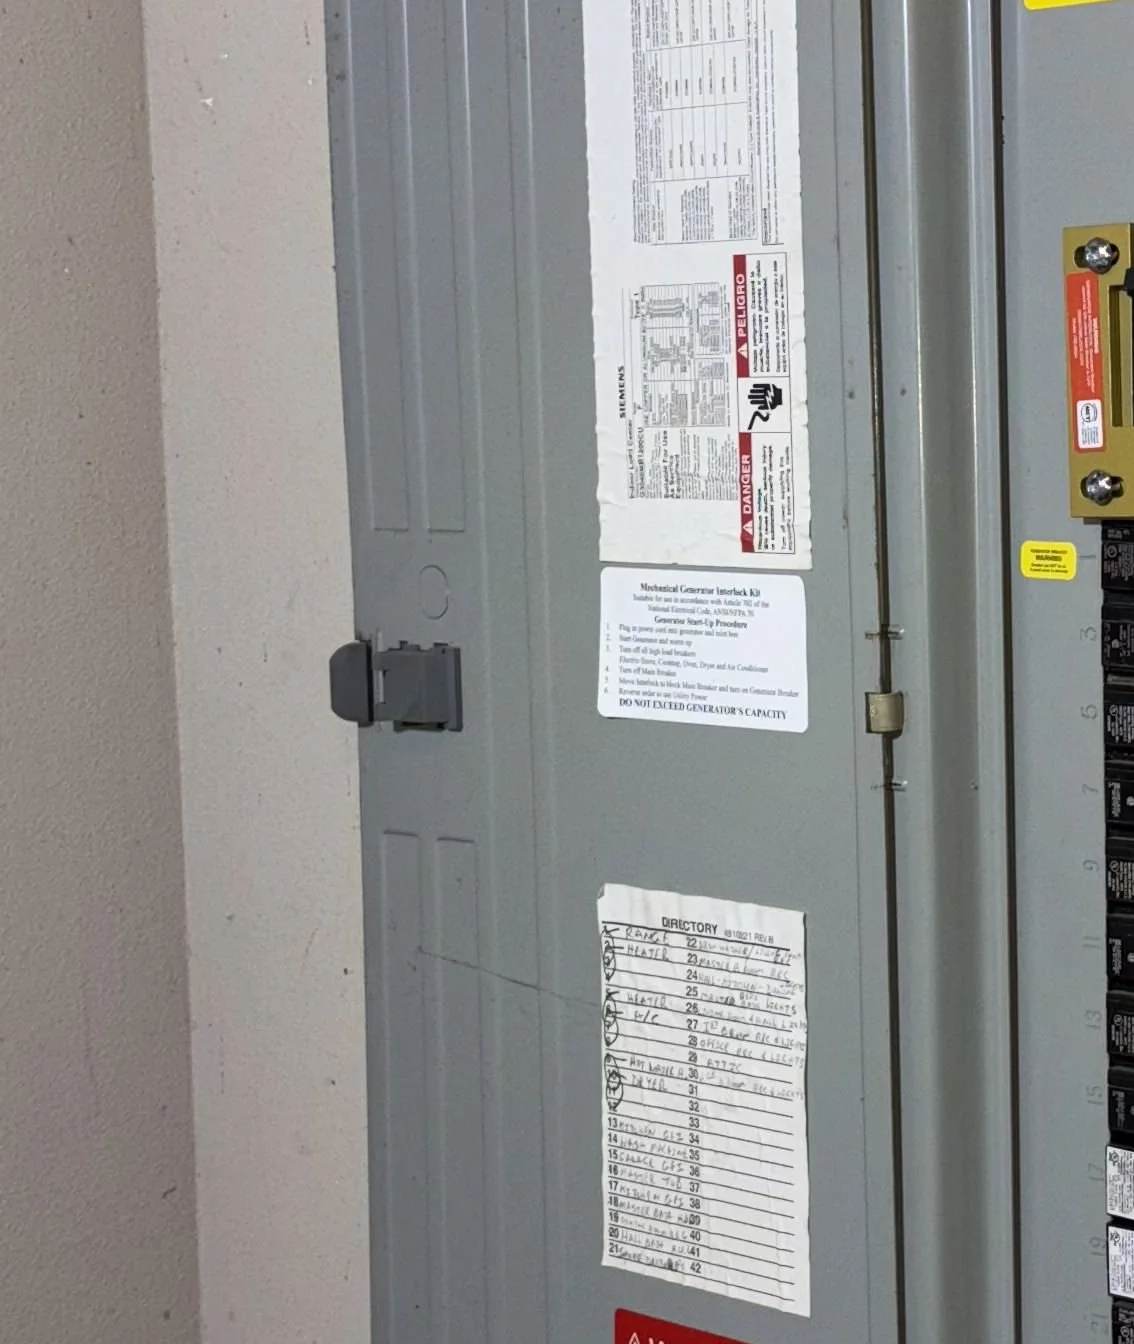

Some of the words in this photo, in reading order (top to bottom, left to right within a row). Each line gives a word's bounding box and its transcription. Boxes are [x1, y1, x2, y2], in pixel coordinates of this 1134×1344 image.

[736, 273, 746, 337] PELIGRO
[618, 365, 626, 419] SIEMENS
[741, 454, 752, 514] DANGER
[662, 916, 718, 935] DIRECTORY
[686, 937, 697, 948] 22
[687, 953, 698, 964] 23
[686, 969, 698, 980] 24
[686, 986, 698, 996] 25
[686, 1002, 698, 1014] 26
[687, 1019, 698, 1030] 27
[688, 1067, 699, 1079] 30
[688, 1084, 698, 1096] 31
[688, 1100, 699, 1112] 32
[608, 1116, 618, 1128] 13
[689, 1116, 700, 1128] 33
[608, 1132, 618, 1144] 14
[689, 1132, 700, 1144] 34
[608, 1149, 618, 1160] 15
[689, 1149, 700, 1161] 35
[689, 1165, 700, 1176] 36
[608, 1181, 618, 1191] 17
[689, 1181, 700, 1192] 37
[690, 1197, 701, 1209] 38
[690, 1230, 701, 1242] 40
[609, 1242, 618, 1253] 21
[690, 1246, 700, 1257] 41
[690, 1262, 702, 1274] 42
